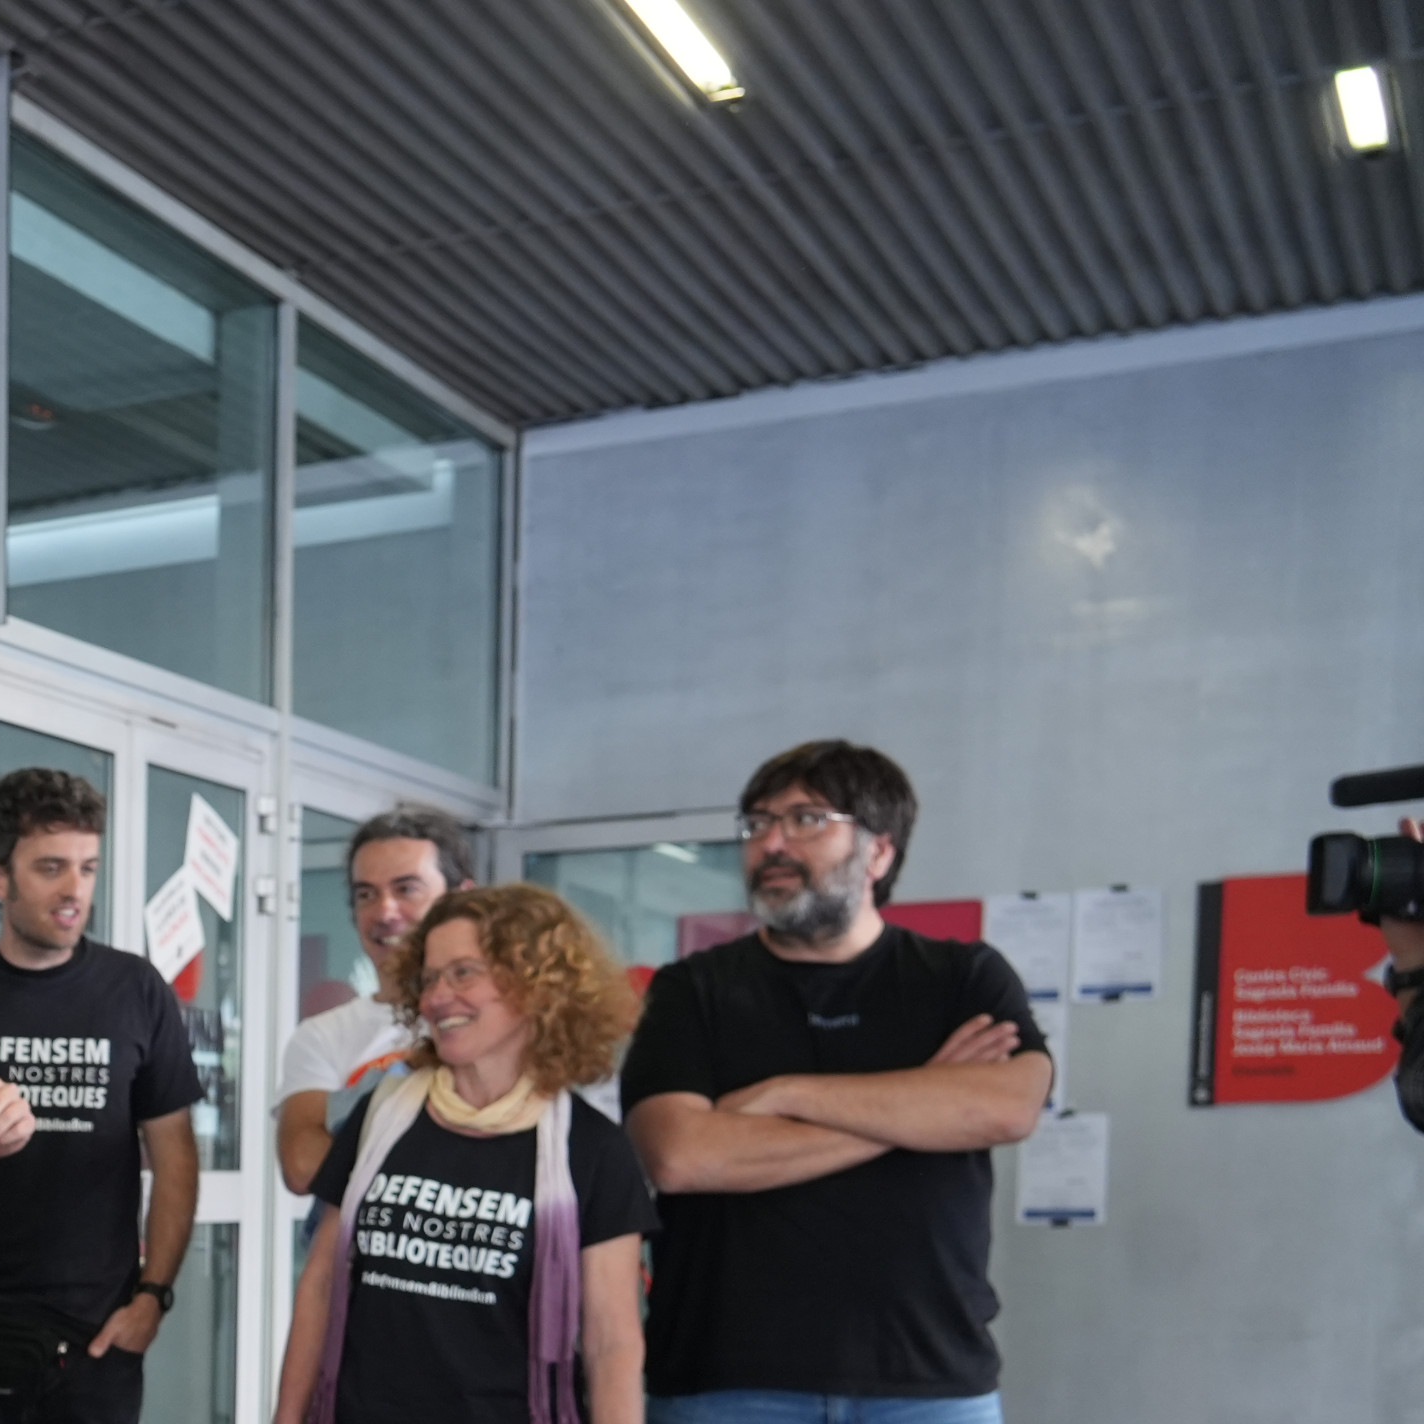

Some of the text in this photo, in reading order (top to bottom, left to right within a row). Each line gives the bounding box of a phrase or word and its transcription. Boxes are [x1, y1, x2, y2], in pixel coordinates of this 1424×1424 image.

[8, 1065, 111, 1086] NOSTRES
[364, 1172, 533, 1229] DEFENSEM
[402, 1211, 526, 1251] NOSTRES
